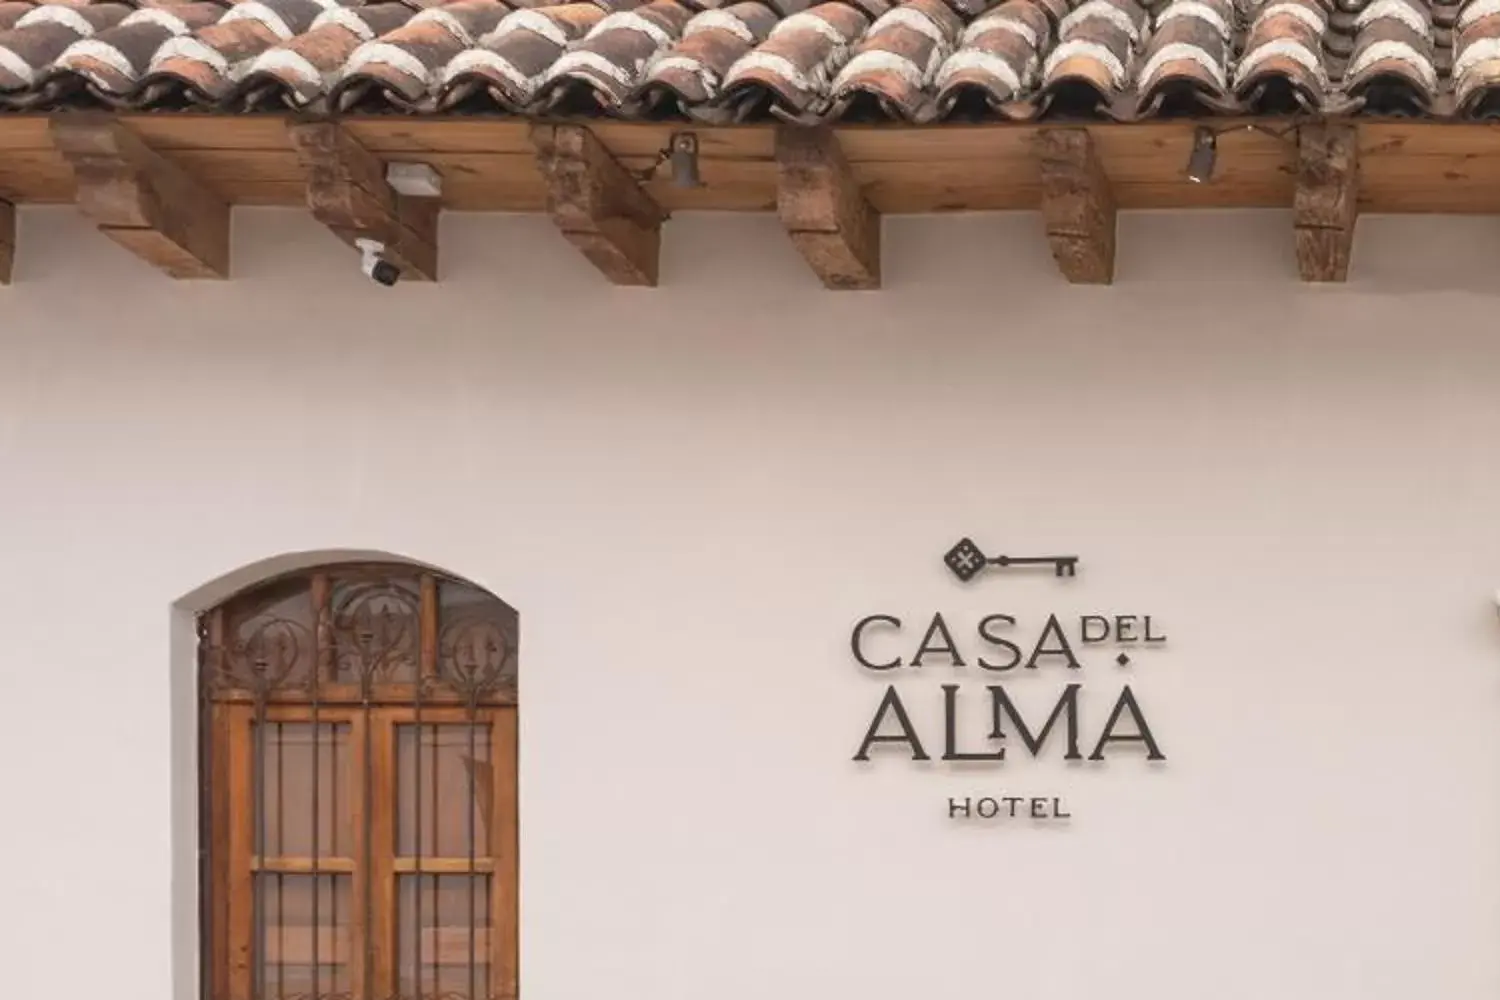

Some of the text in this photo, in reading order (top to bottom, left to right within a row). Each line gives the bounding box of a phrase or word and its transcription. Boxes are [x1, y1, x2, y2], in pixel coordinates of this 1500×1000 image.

[851, 611, 1167, 671] CASA DEL
[852, 683, 1167, 761] ALMA
[948, 797, 1071, 819] HOTEL
